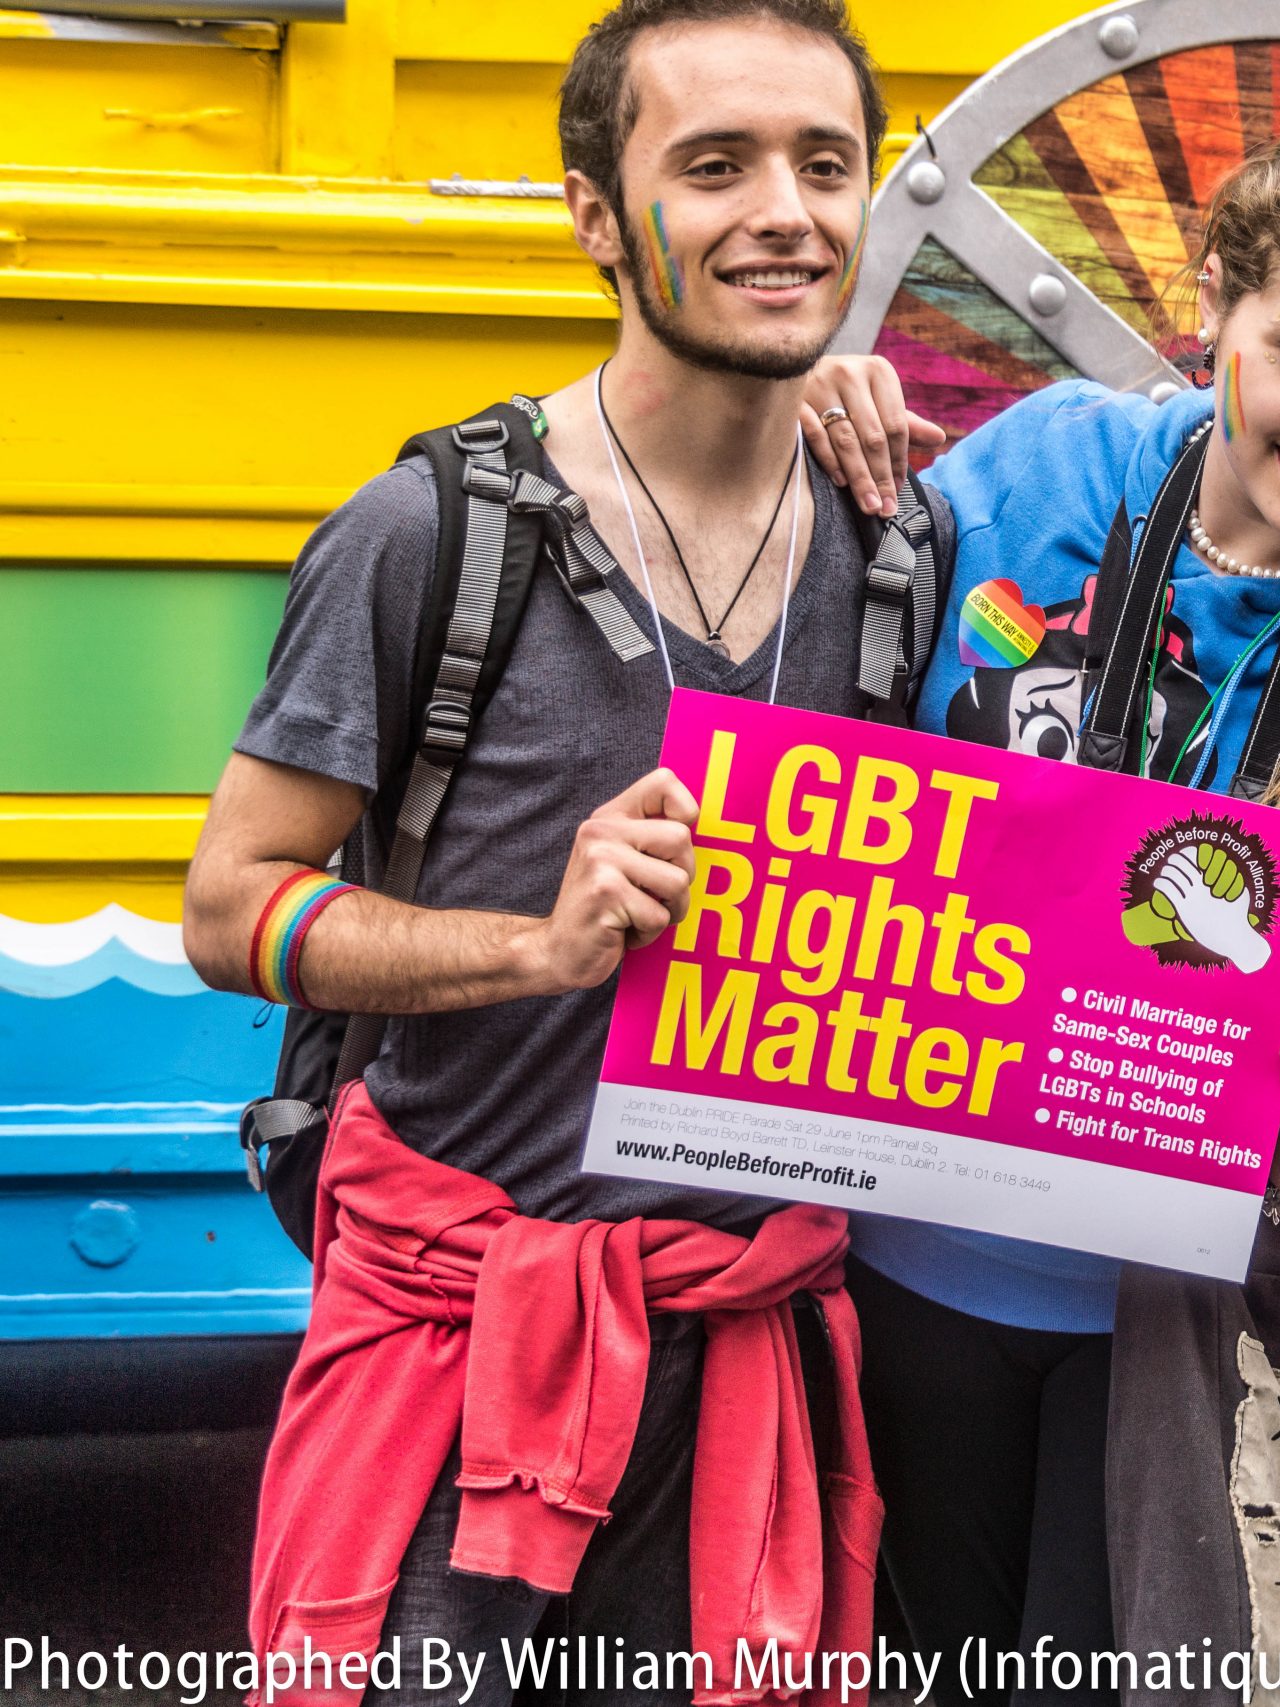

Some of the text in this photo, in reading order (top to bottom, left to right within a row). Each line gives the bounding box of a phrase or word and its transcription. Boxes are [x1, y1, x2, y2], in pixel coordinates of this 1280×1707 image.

[970, 594, 1018, 637] BORN THIS WAY
[695, 729, 1000, 879] LGBT
[1139, 826, 1265, 909] People Before Profit Alliance
[672, 845, 1032, 1005] Rights
[650, 960, 1025, 1117] Matter
[1052, 1013, 1234, 1066] Same-Sex Couples
[1083, 989, 1251, 1041] Civil Marriage for
[1039, 1073, 1206, 1124] LGBTs in Schools
[1069, 1050, 1224, 1098] Stop Bullying of
[620, 1113, 658, 1130] Printed
[661, 1118, 674, 1133] by
[677, 1121, 718, 1138] Richard
[720, 1127, 750, 1143] Boyd
[752, 1132, 788, 1149] Barrett
[791, 1136, 810, 1152] TD,
[813, 1140, 856, 1157] Leinster
[858, 1147, 897, 1165] House,
[900, 1154, 935, 1171] Dublin
[974, 1168, 989, 1180] 01
[993, 1171, 1017, 1186] 618
[1019, 1176, 1051, 1192] 3449
[623, 1098, 646, 1111] Join
[649, 1101, 667, 1114] the
[669, 1103, 703, 1118] Dublin
[705, 1108, 741, 1125] PRIDE
[743, 1114, 781, 1130] Parade
[784, 1119, 803, 1133] Sat
[806, 1122, 822, 1136] 29
[824, 1126, 852, 1140] June
[856, 1131, 880, 1146] 1pm
[922, 1141, 938, 1157] Sq
[1056, 1109, 1262, 1169] Fight for Trans Rights
[616, 1140, 877, 1190] www.PeopleBeforeProfit.ie
